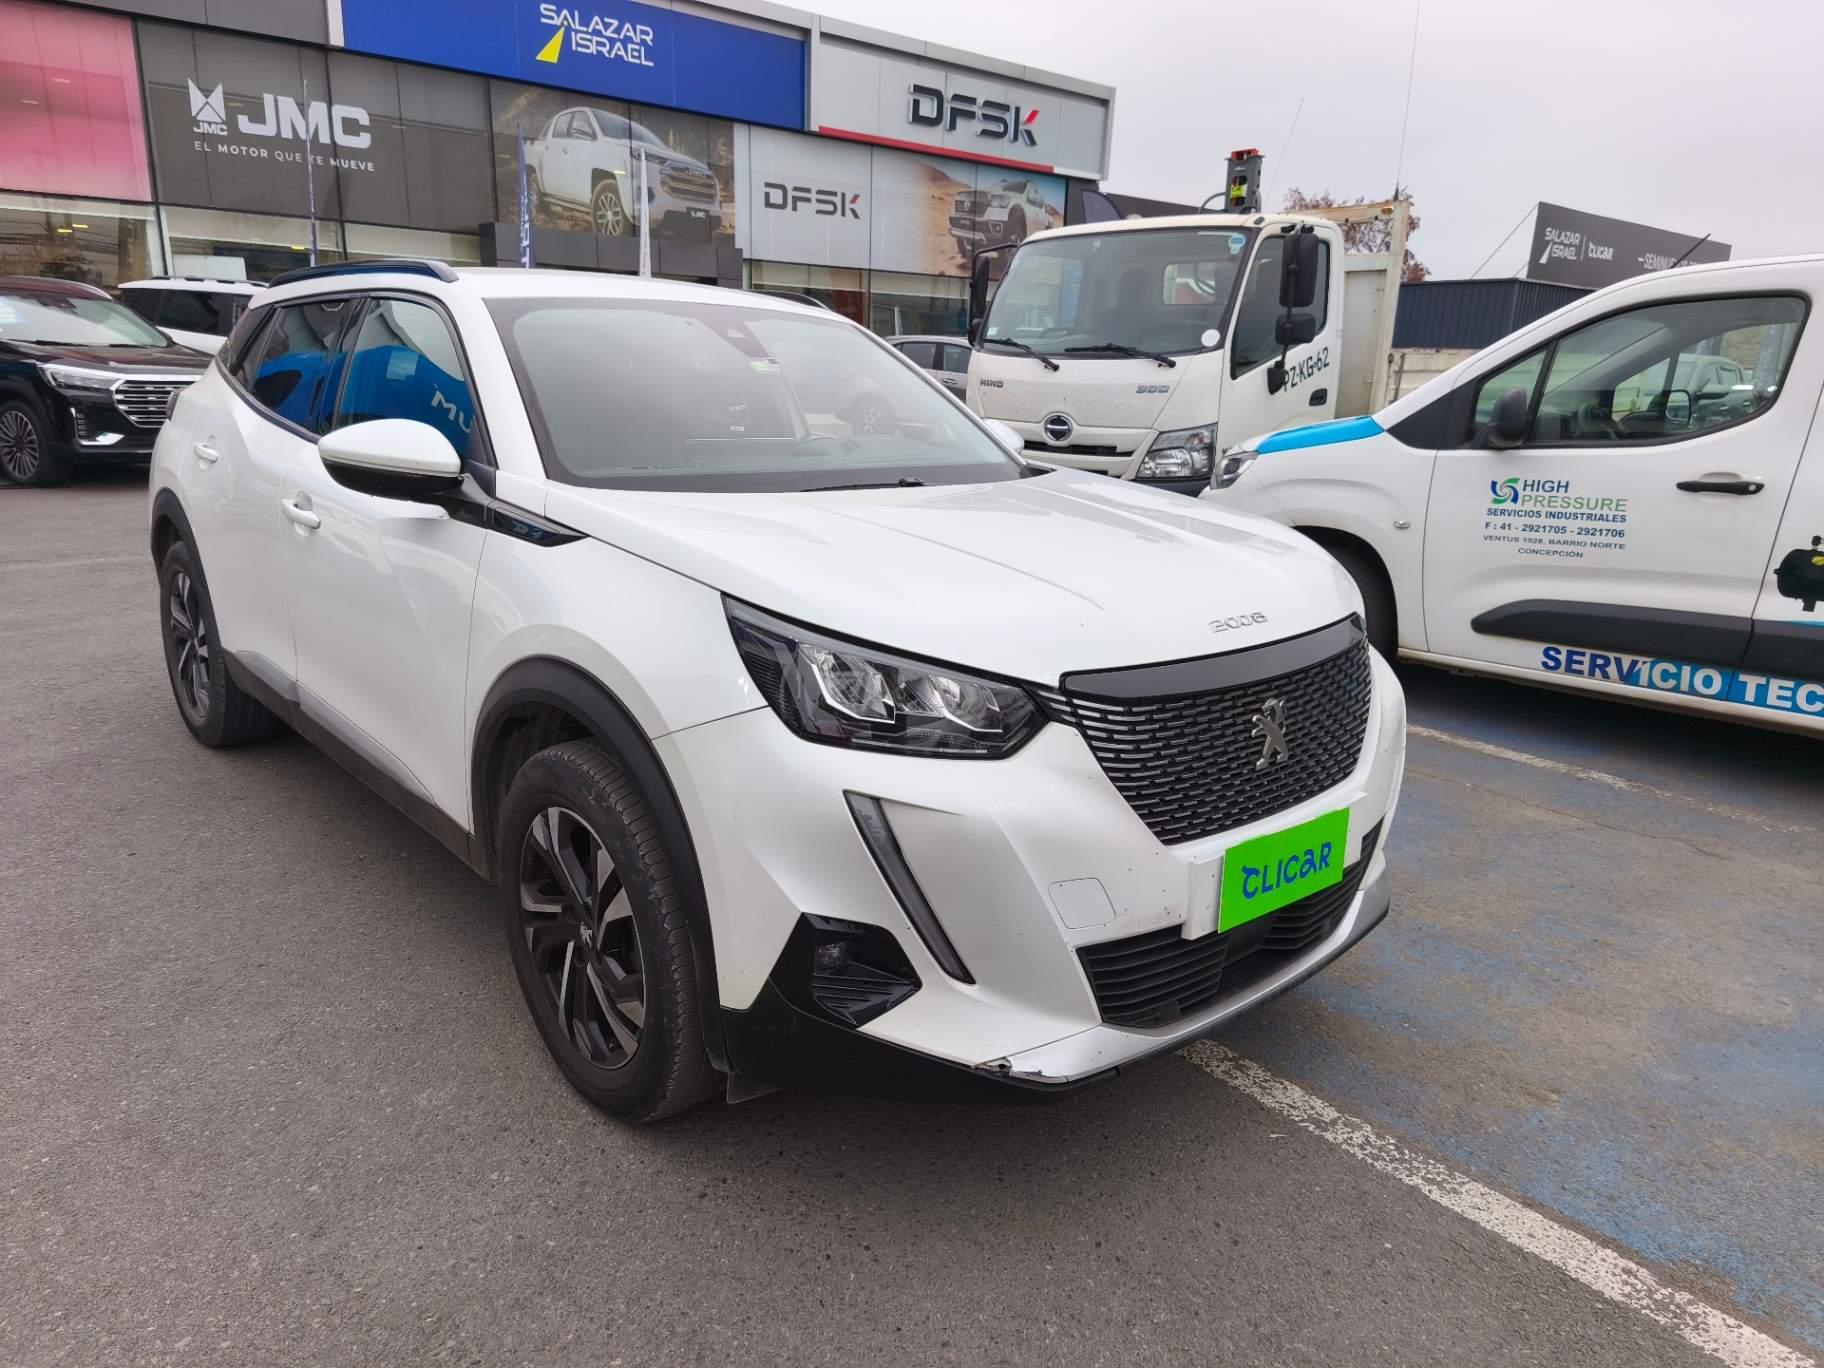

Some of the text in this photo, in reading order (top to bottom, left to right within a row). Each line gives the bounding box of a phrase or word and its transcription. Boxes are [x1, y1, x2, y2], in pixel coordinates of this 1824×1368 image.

[540, 3, 654, 46] SALAZAR
[571, 31, 655, 67] ISRAEL
[237, 93, 372, 149] JMC
[908, 83, 1040, 147] DFSK
[193, 122, 228, 136] JMC
[194, 140, 375, 172] EL MOTOR QUE TE MUEVE
[764, 181, 861, 220] DFSK
[1544, 227, 1581, 246] SALAZAR
[1551, 244, 1577, 261] ISRAEL
[1522, 479, 1570, 493] HIGH
[1520, 494, 1628, 512] PRESSURE
[1486, 508, 1627, 523] SERVICIOS INDUSTRIALES
[1499, 522, 1512, 531] 41
[1521, 524, 1567, 535] 2921705
[1576, 527, 1625, 538] 2921706
[1483, 535, 1520, 543] VENTUS
[1548, 539, 1588, 548] BARRIO
[1589, 541, 1626, 550] NORTE
[1518, 547, 1584, 558] CONCEPCIÓN
[1541, 646, 1722, 696] SERVICIO
